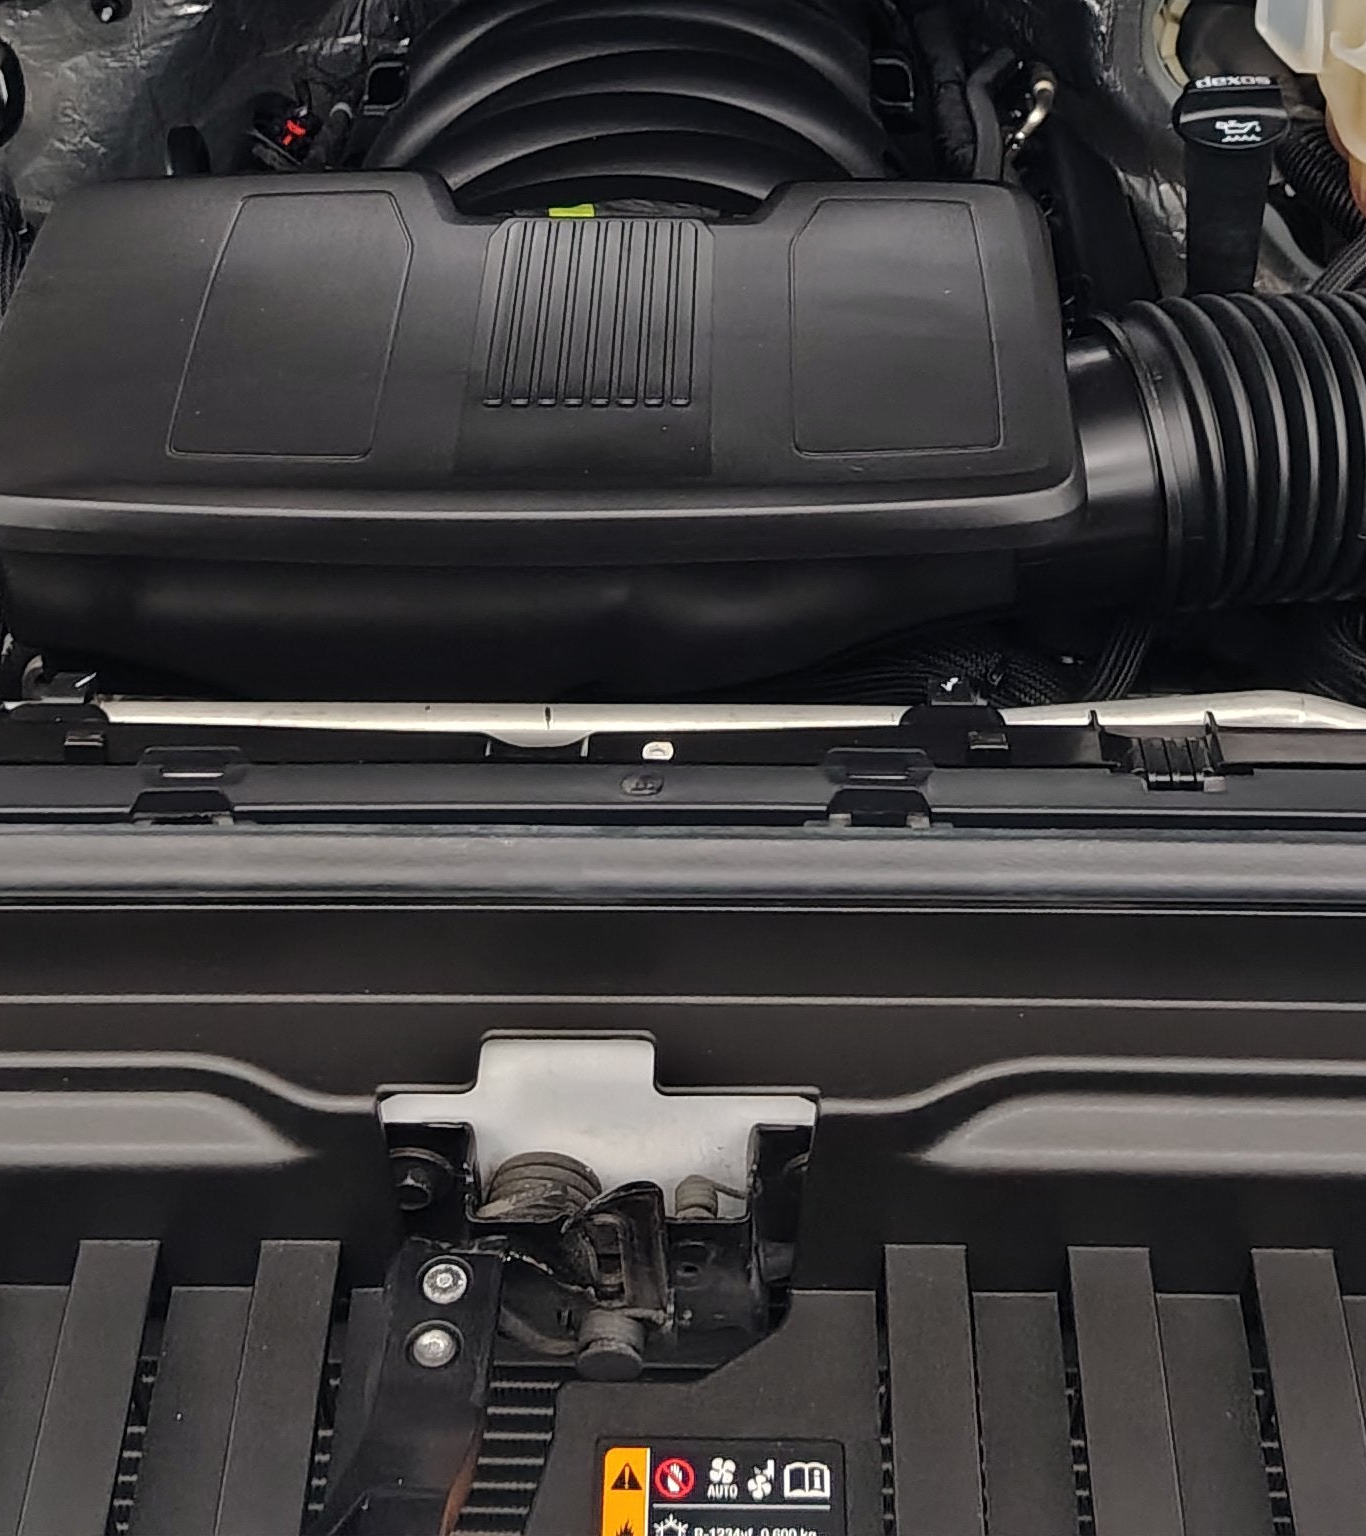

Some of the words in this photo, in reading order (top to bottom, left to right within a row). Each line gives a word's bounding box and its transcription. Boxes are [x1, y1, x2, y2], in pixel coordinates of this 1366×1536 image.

[1195, 75, 1271, 89] dexos
[707, 1483, 739, 1501] AUTO
[760, 1526, 797, 1536] 0600
